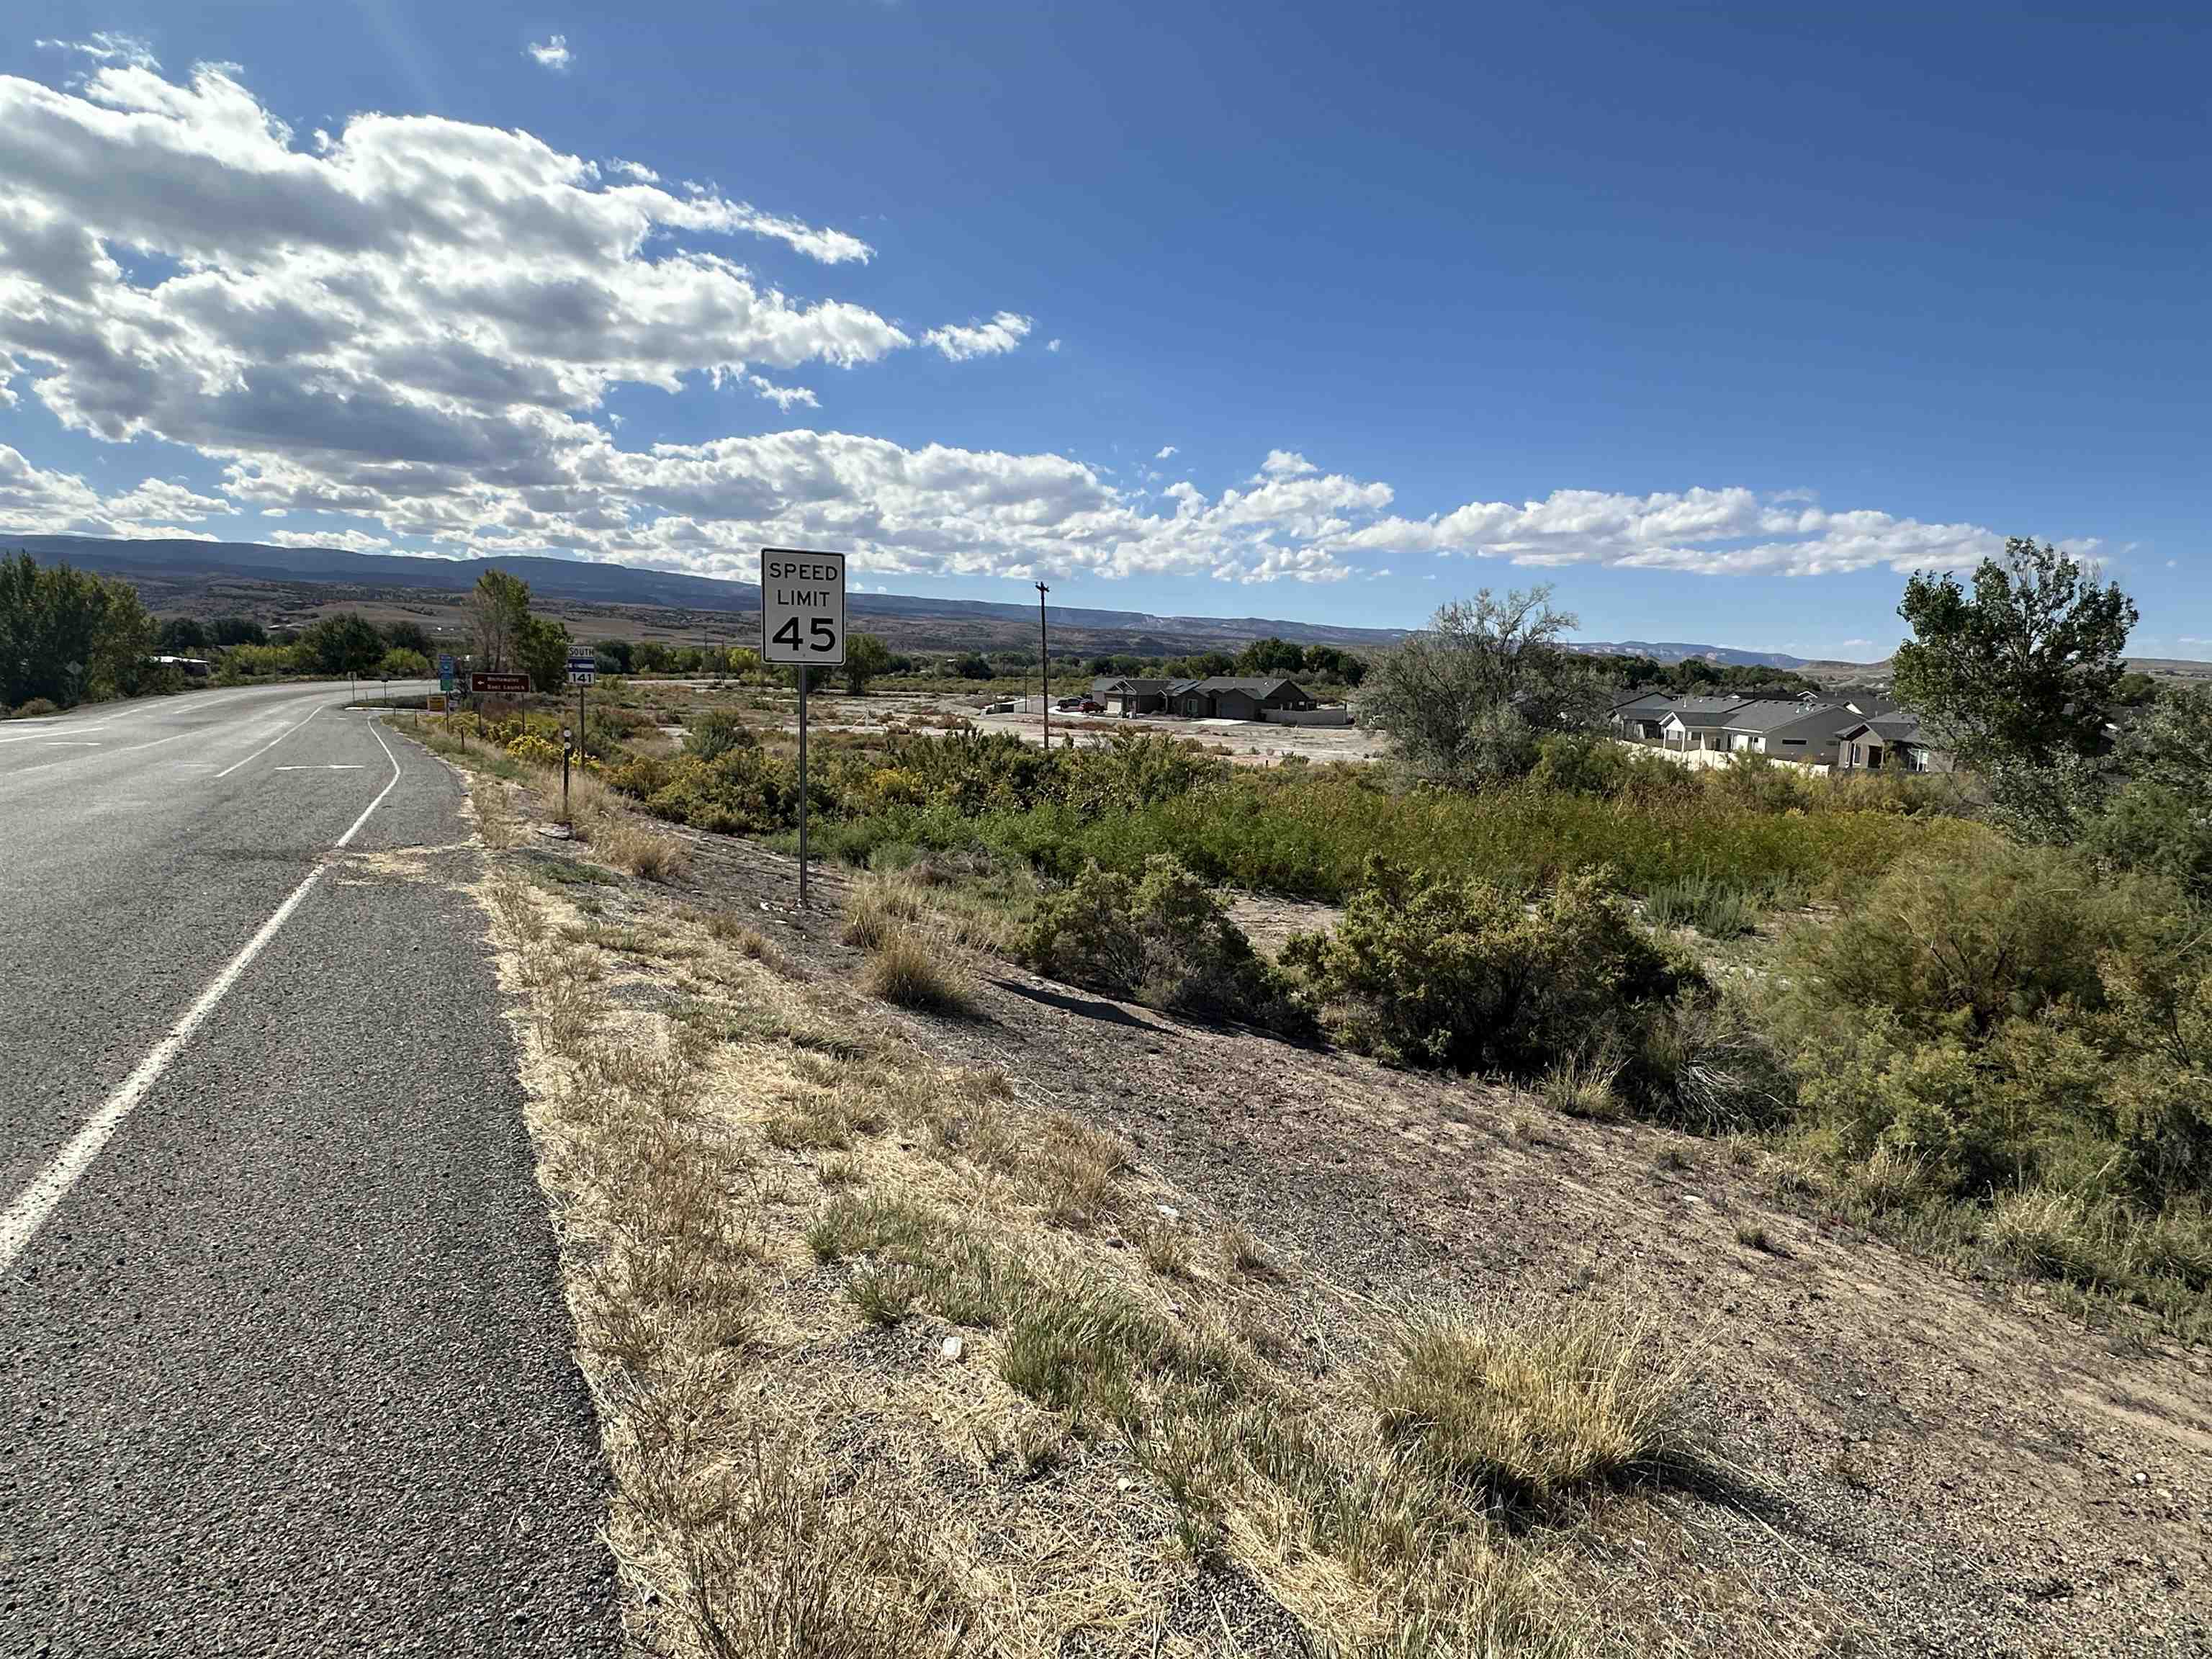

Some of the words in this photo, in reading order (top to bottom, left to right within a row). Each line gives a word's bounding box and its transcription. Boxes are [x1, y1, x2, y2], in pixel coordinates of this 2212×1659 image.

[770, 562, 837, 580] SPEED
[778, 590, 830, 606] LIMIT
[772, 617, 835, 652] 45
[570, 647, 594, 656] SOUTH
[572, 673, 591, 683] 141
